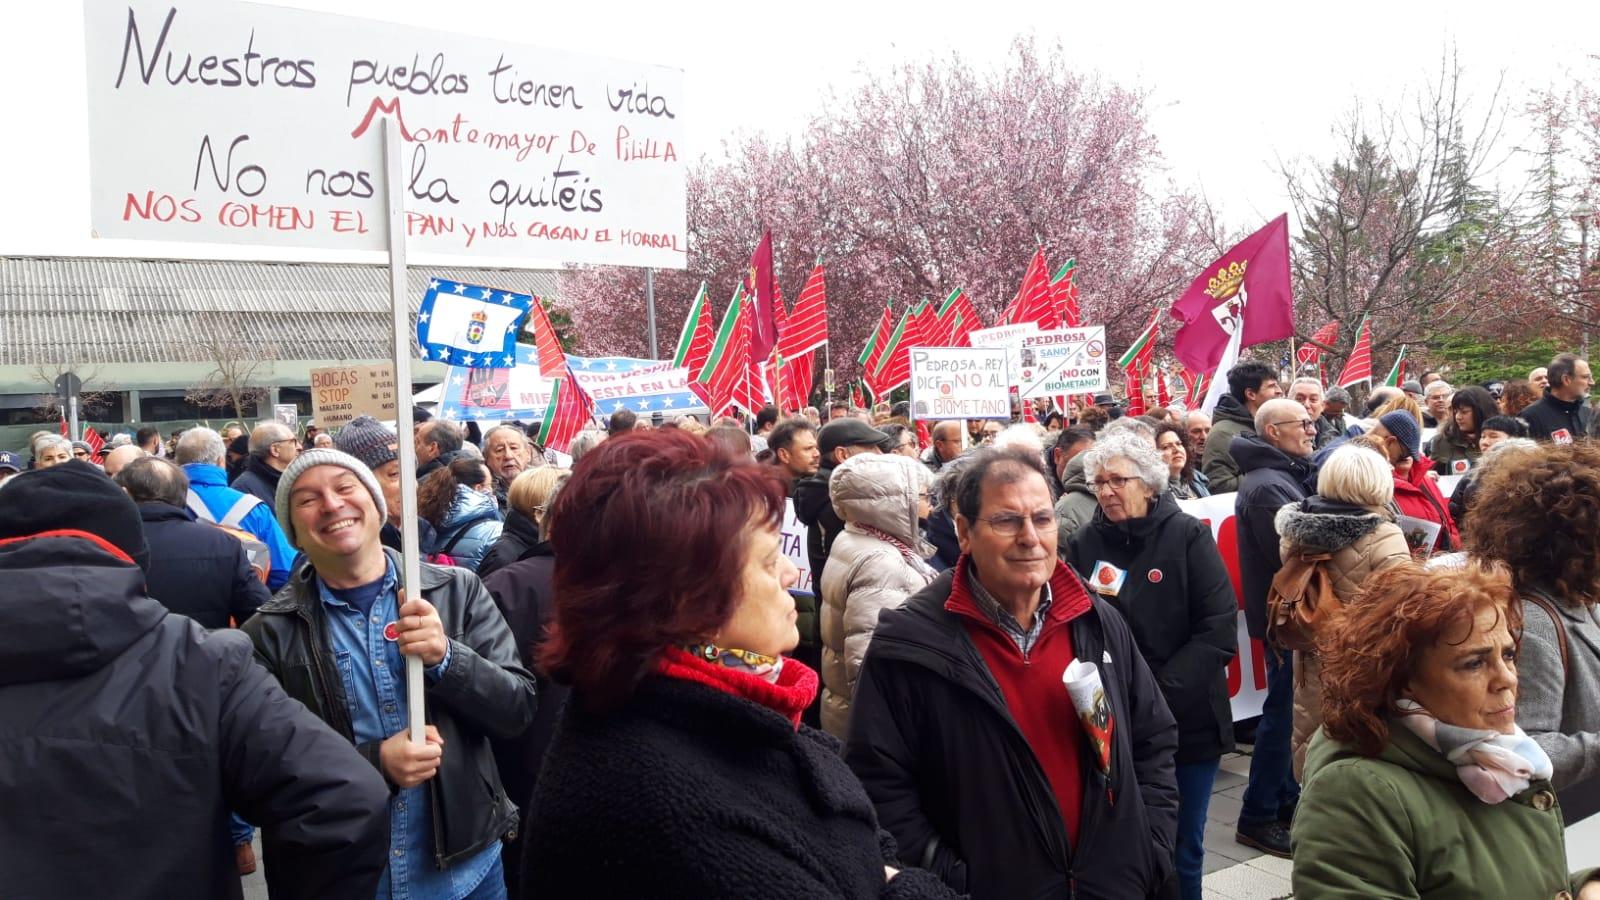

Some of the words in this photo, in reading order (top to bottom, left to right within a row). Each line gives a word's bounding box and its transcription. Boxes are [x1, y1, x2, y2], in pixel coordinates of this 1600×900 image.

[116, 7, 316, 88] Nuestros
[347, 52, 469, 107] pueblos
[488, 53, 584, 109] tienen
[607, 81, 675, 119] vida
[351, 96, 559, 162] Montemayor
[568, 130, 596, 155] De
[194, 135, 267, 197] No
[307, 169, 374, 198] nos
[408, 143, 460, 203] la
[490, 154, 603, 227] quitéis
[123, 191, 202, 222] NOS
[218, 201, 314, 230] COMEN
[329, 210, 369, 233] EL
[405, 211, 454, 236] PAN
[483, 221, 517, 238] NOS
[528, 221, 588, 241] CAGAN
[595, 229, 613, 242] EL
[1022, 332, 1087, 348] ¡PEDROSA
[1040, 346, 1070, 357] SANO!
[913, 351, 977, 372] PEDROSA
[985, 358, 1003, 370] REY
[955, 373, 982, 388] NO
[988, 372, 1005, 388] AL
[1080, 368, 1099, 377] CON
[592, 382, 637, 399] ESTÁ
[641, 381, 664, 392] EN
[1045, 377, 1101, 391] BIOMETANO!
[320, 388, 349, 403] STOP
[934, 399, 1006, 414] BIOMETANO
